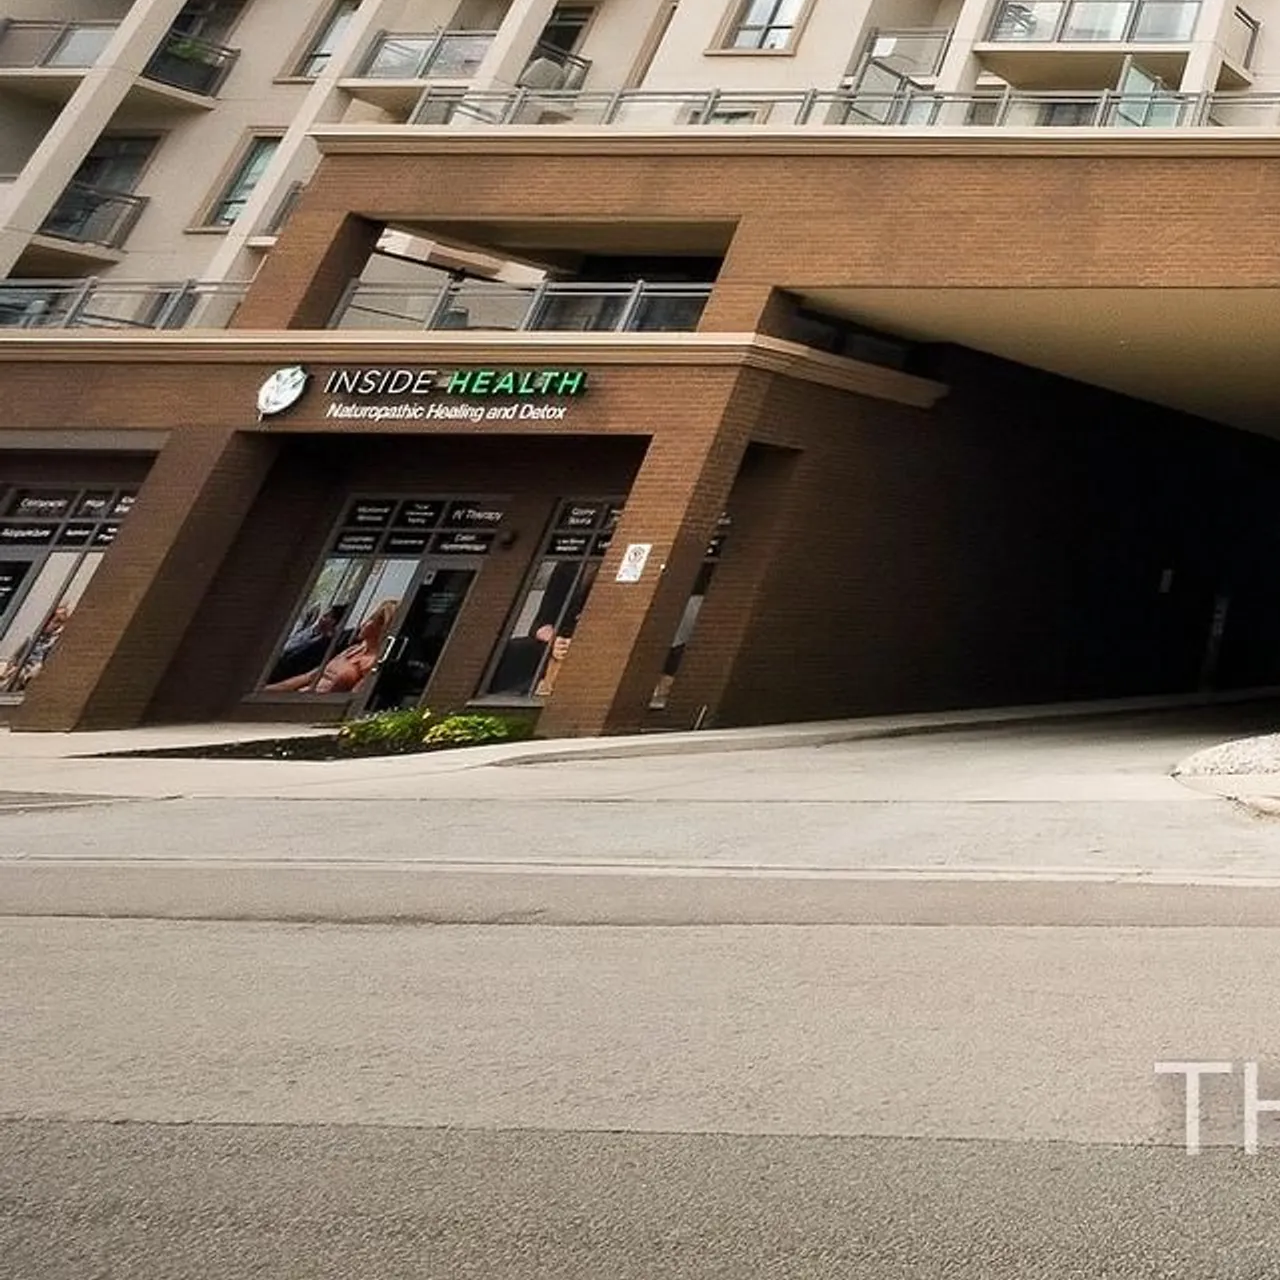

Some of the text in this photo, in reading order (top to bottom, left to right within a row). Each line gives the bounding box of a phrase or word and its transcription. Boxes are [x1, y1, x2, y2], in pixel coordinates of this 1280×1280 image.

[323, 369, 584, 396] INSIDE HEALTH
[326, 402, 567, 422] Naturopathic Healing and Detox
